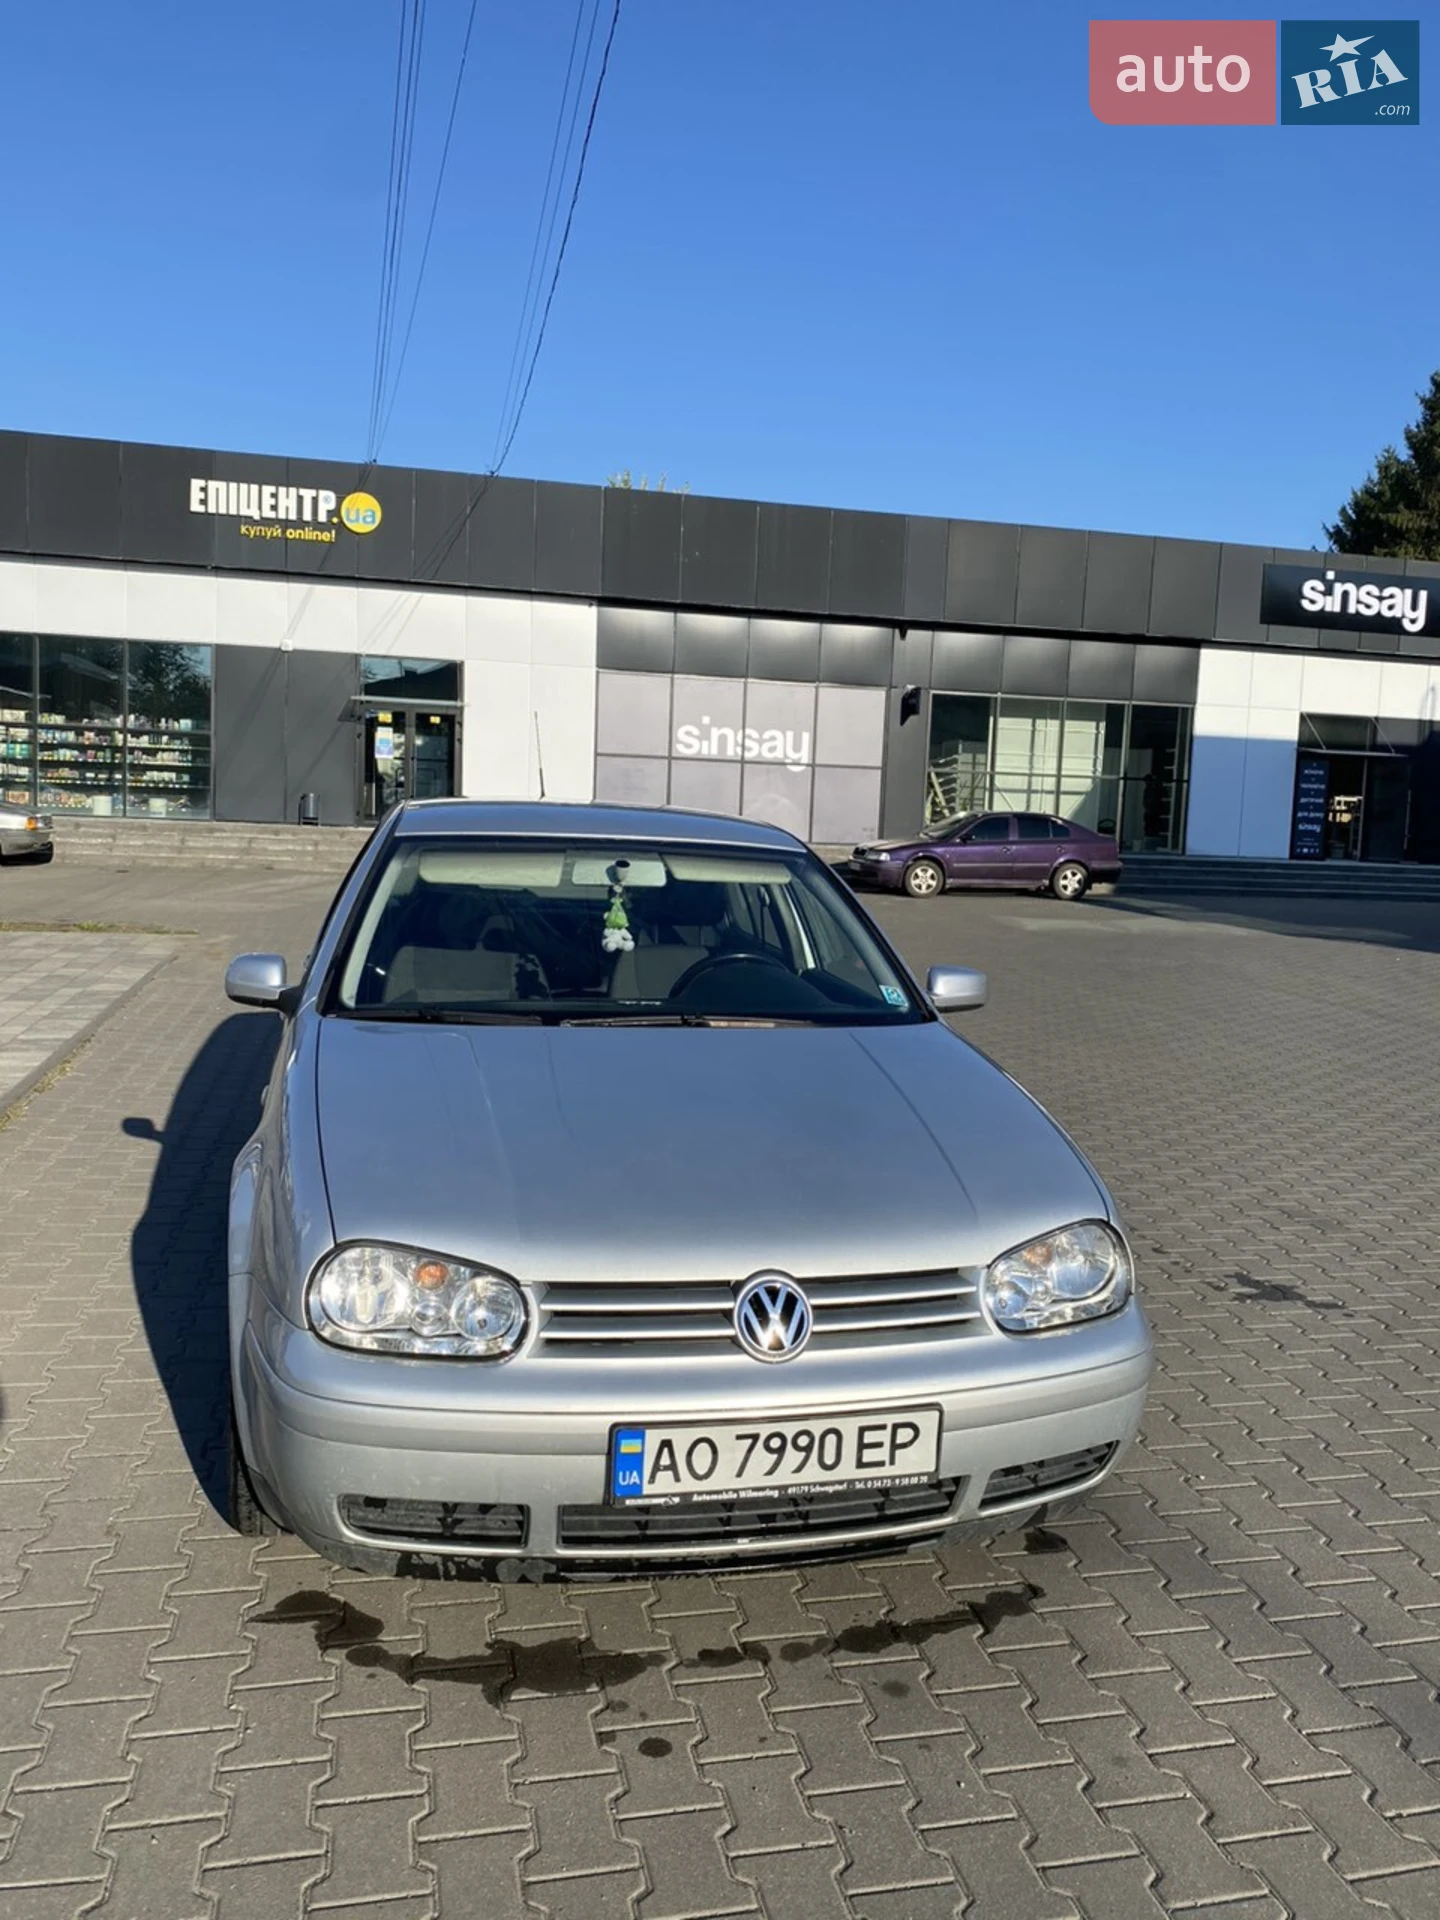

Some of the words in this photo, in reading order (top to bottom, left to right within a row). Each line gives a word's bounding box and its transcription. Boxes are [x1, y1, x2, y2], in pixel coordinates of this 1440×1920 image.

[240, 523, 281, 540] купуй
[286, 526, 336, 543] online!
[1300, 570, 1428, 633] sinsay
[676, 715, 810, 773] sinsay
[618, 1473, 641, 1486] UA
[647, 1435, 719, 1486] AO
[734, 1426, 844, 1479] 7990
[855, 1420, 921, 1471] EP
